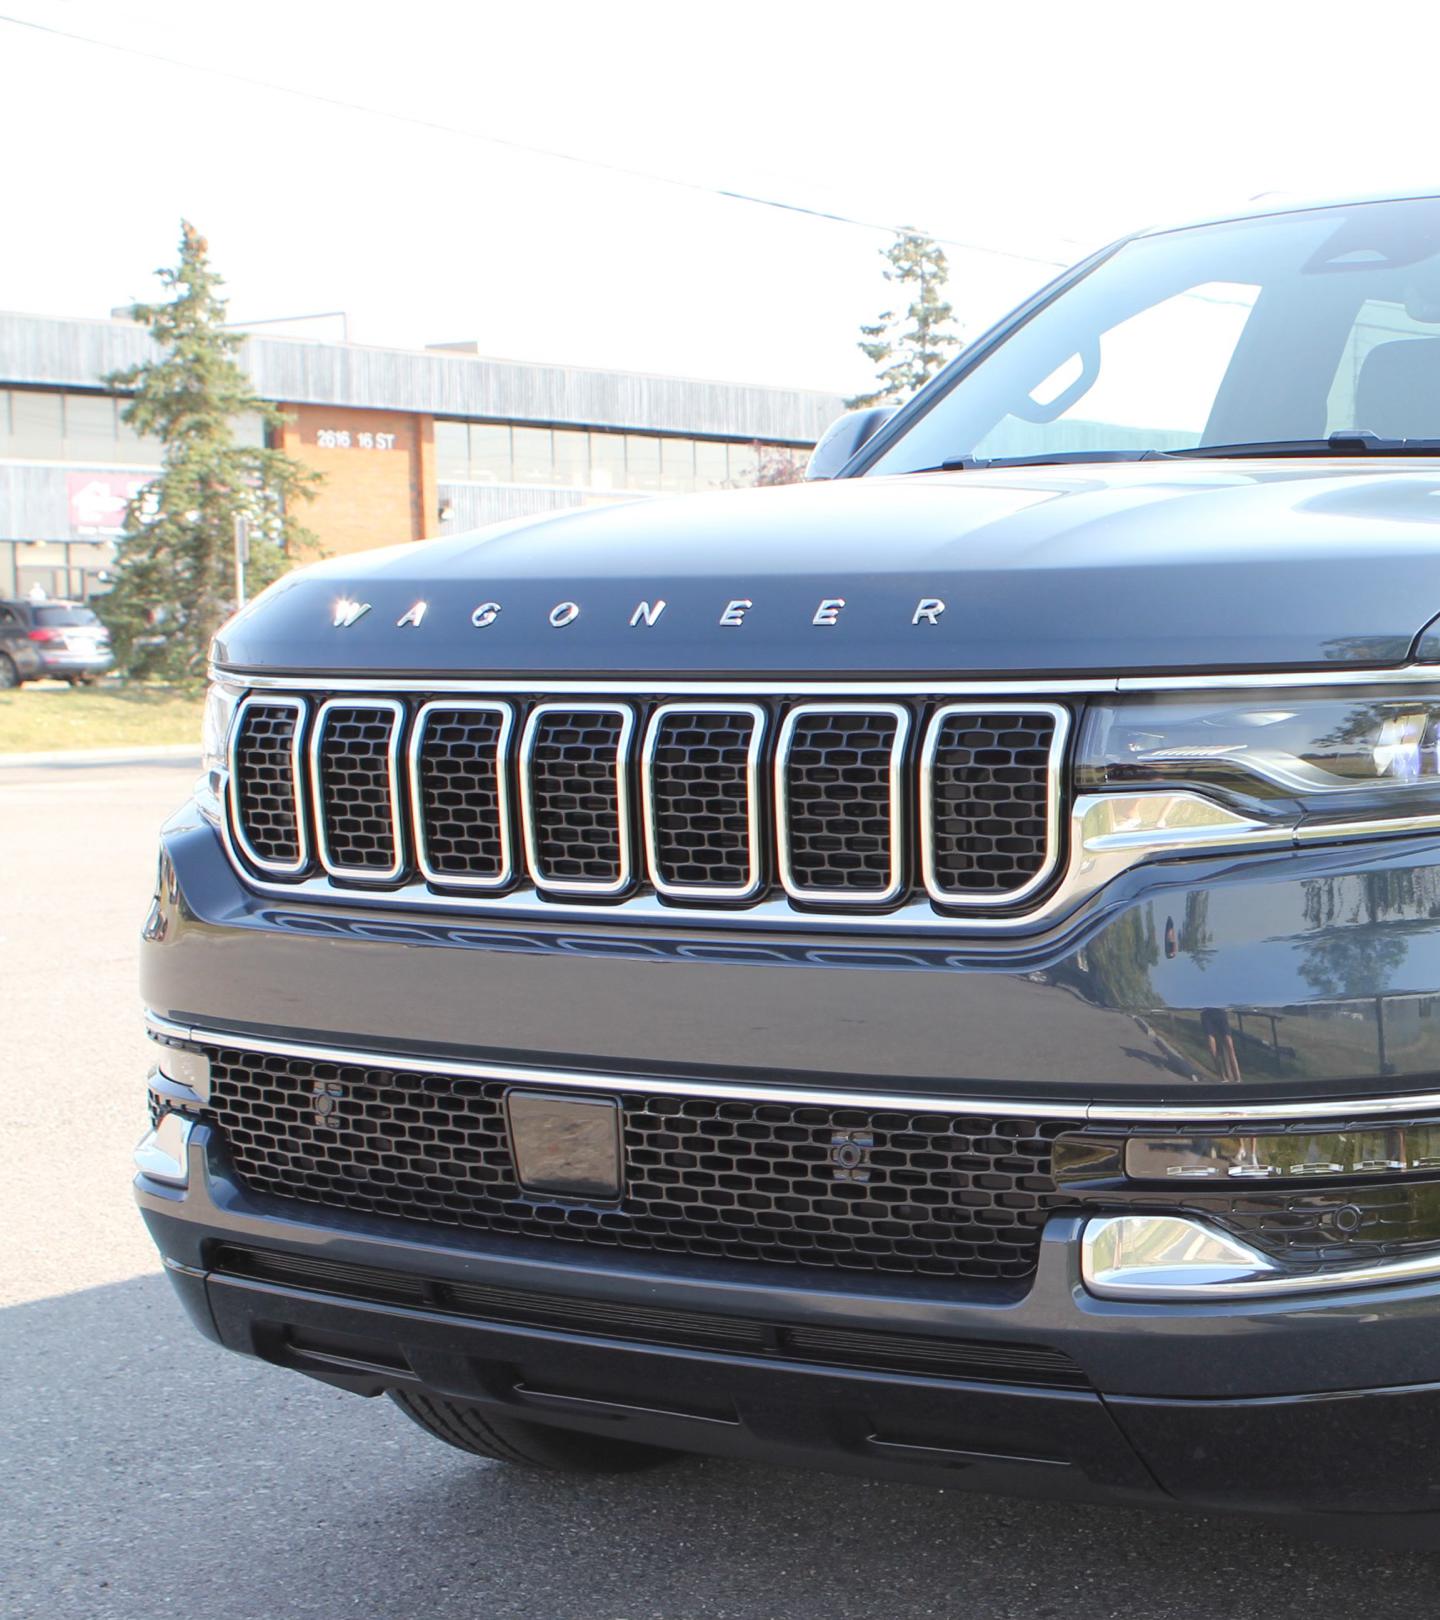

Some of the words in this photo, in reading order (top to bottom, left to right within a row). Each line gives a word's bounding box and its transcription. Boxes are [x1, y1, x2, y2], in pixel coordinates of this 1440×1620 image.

[317, 429, 351, 449] 2616
[356, 431, 373, 449] 16
[375, 431, 396, 450] ST
[333, 598, 946, 628] WAGONEER
